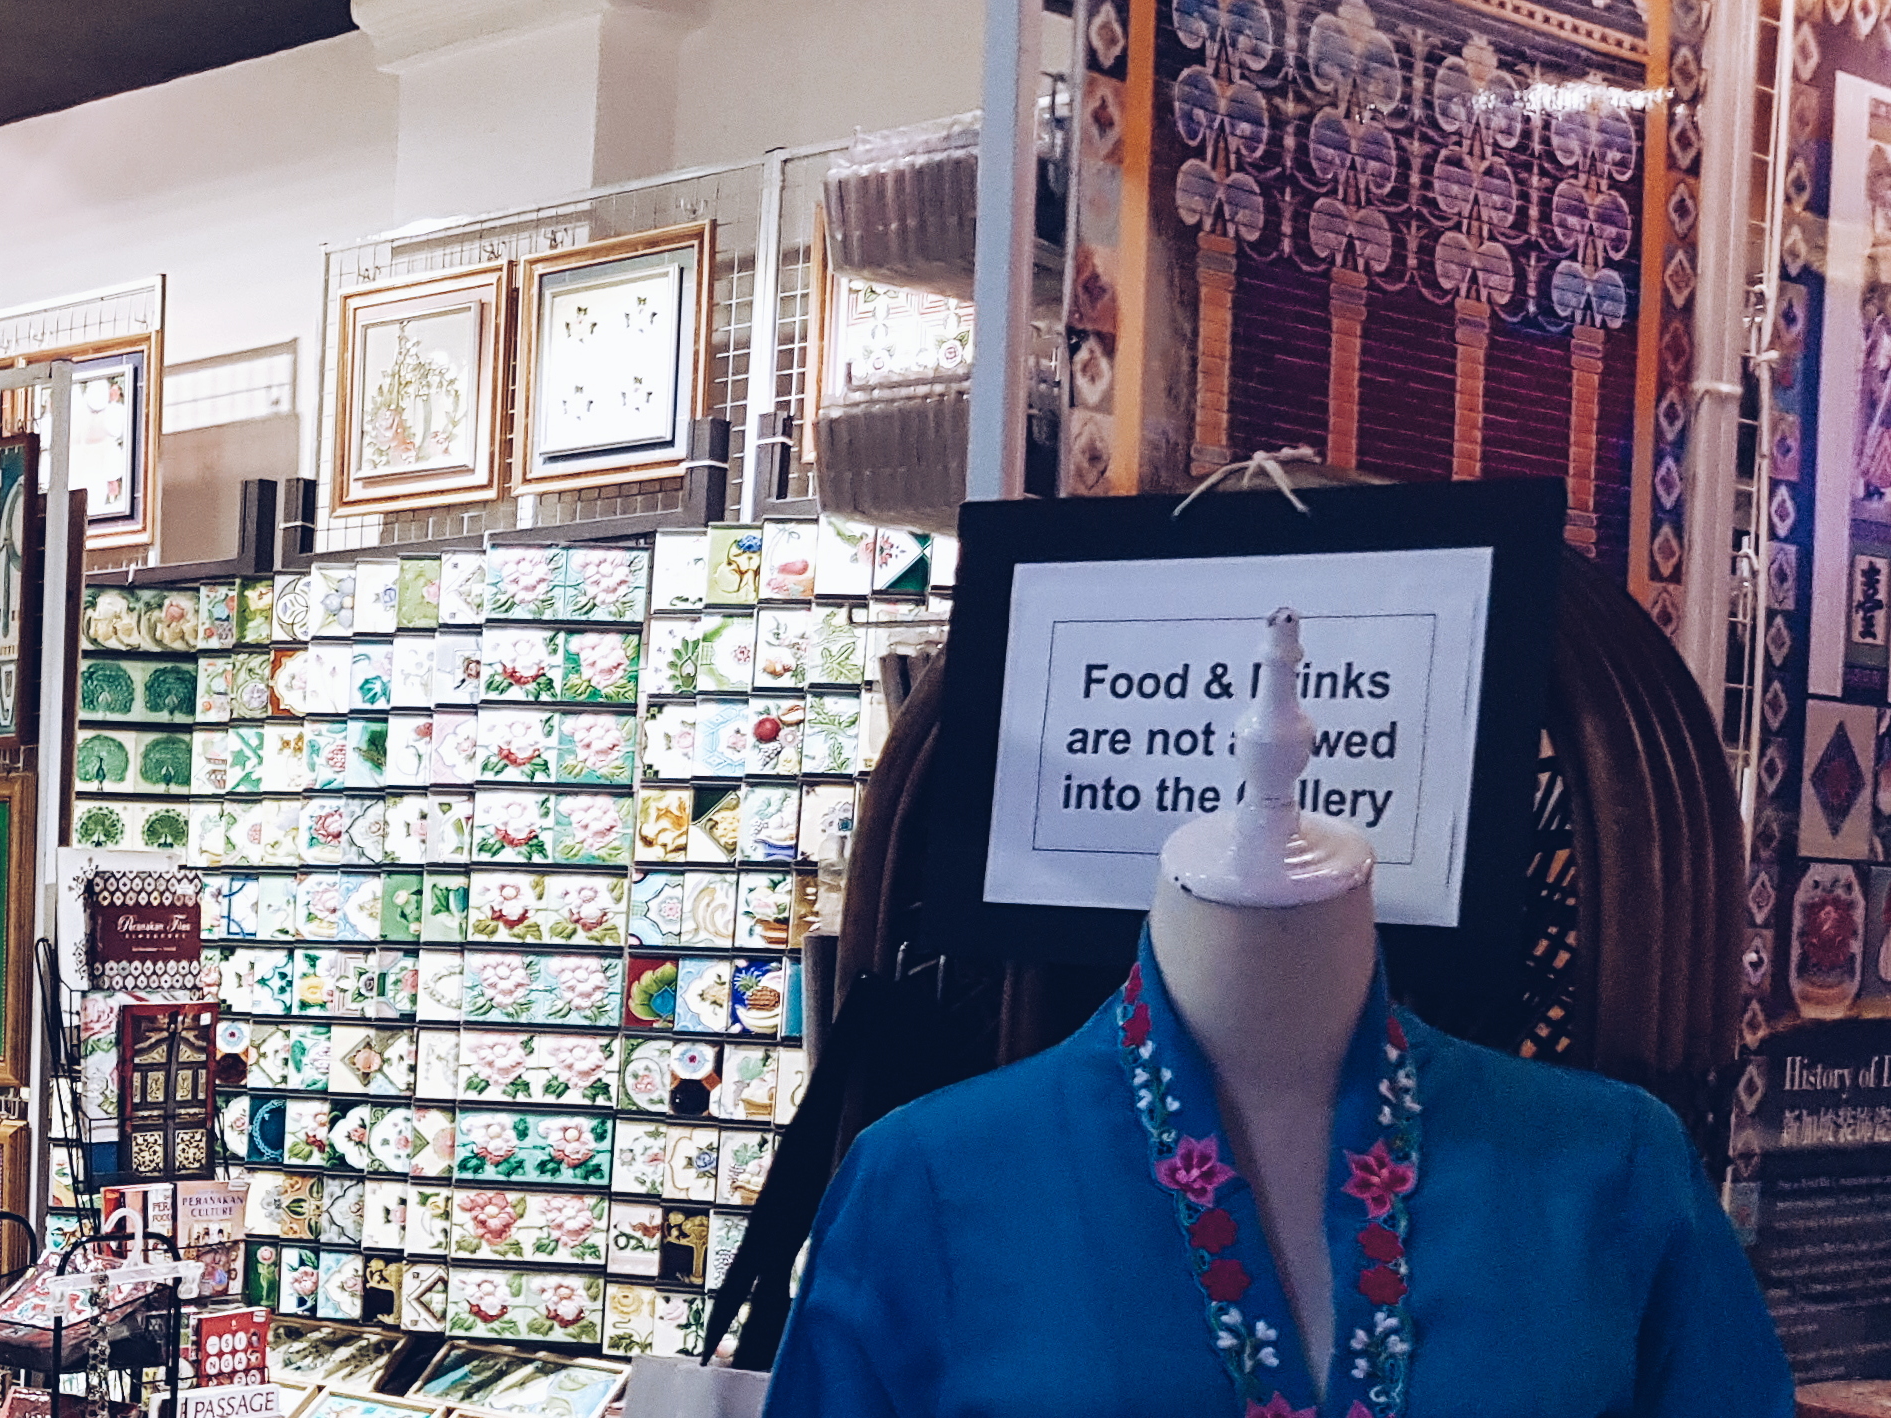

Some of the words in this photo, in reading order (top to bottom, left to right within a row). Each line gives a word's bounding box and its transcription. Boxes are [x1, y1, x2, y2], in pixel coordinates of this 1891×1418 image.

[1083, 663, 1190, 699] Food
[1204, 662, 1234, 699] &
[1250, 661, 1391, 699] inks
[1065, 727, 1132, 755] are
[1146, 721, 1215, 756] not
[1062, 774, 1141, 811] into
[1156, 776, 1221, 813] the
[1237, 778, 1394, 828] llery
[1783, 1056, 1852, 1099] History
[1858, 1056, 1879, 1088] of
[182, 1195, 244, 1206] PERANAKAN
[190, 1206, 234, 1218] CULTURE
